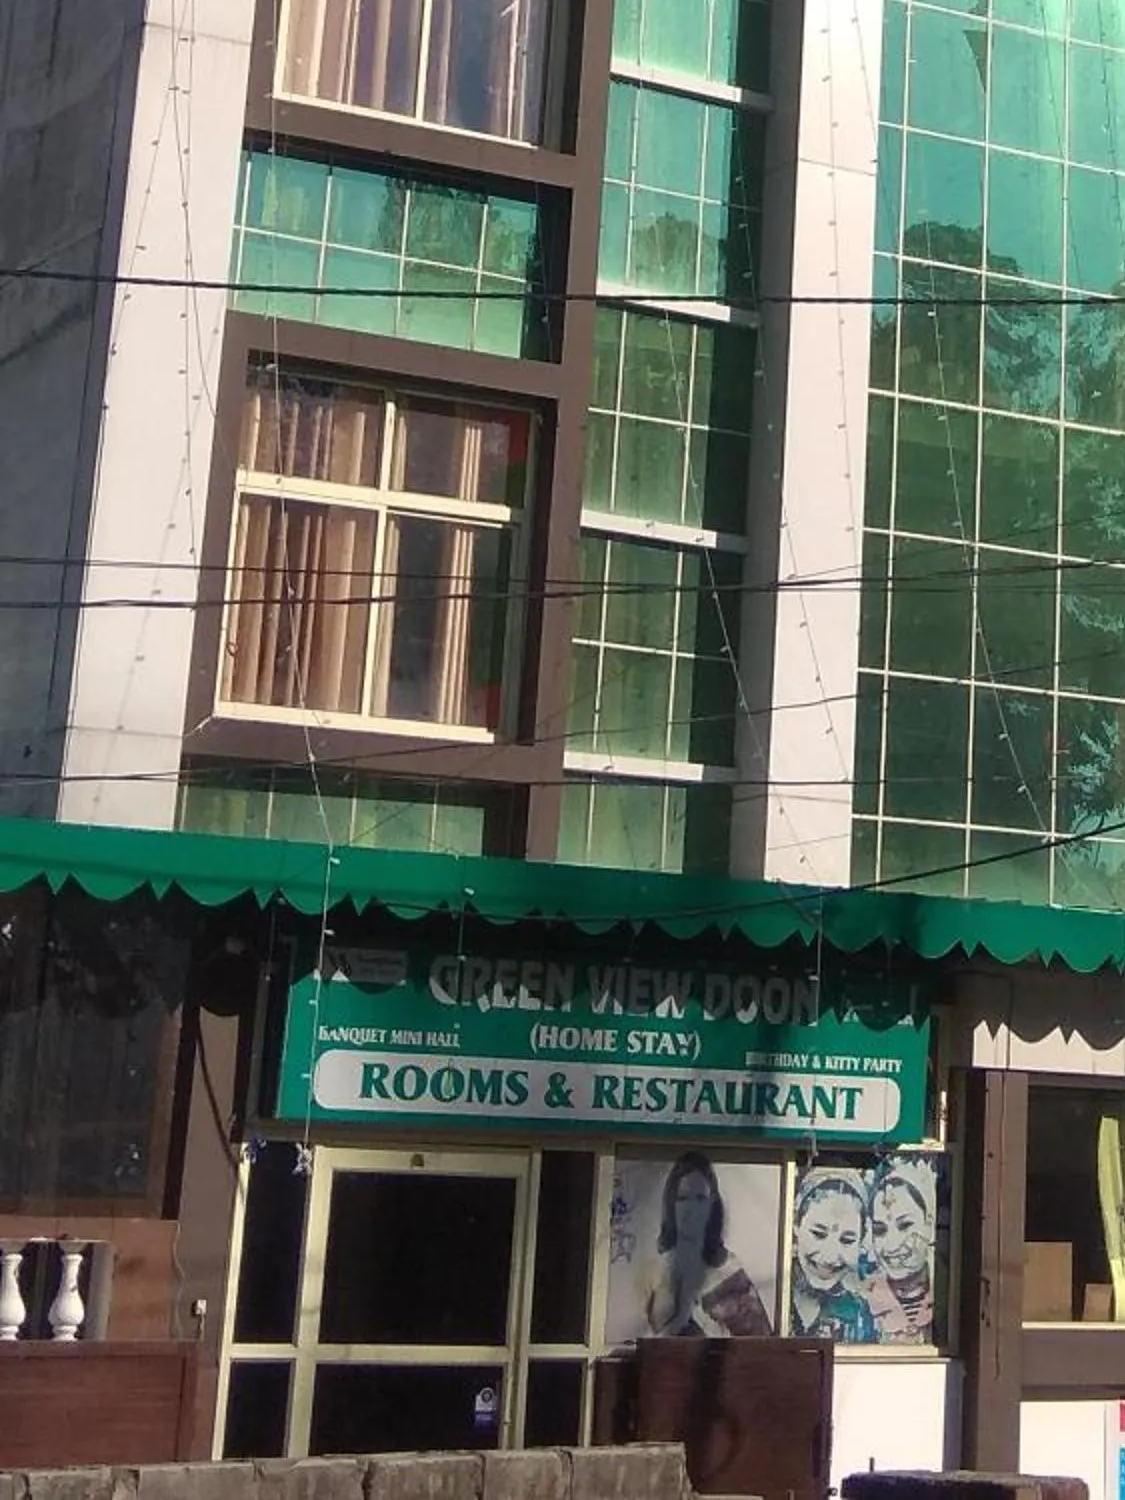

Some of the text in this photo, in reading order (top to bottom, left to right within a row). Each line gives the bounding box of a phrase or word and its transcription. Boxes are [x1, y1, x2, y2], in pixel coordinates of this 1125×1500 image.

[428, 955, 818, 1026] GREEN VIEW DOON
[318, 1025, 461, 1048] BANQUET MINI HALL
[530, 1024, 701, 1060] (HOME STAY)
[745, 1051, 903, 1073] THDAY & KITTY PARTY
[359, 1062, 863, 1120] ROOMS & RESTAURANT
